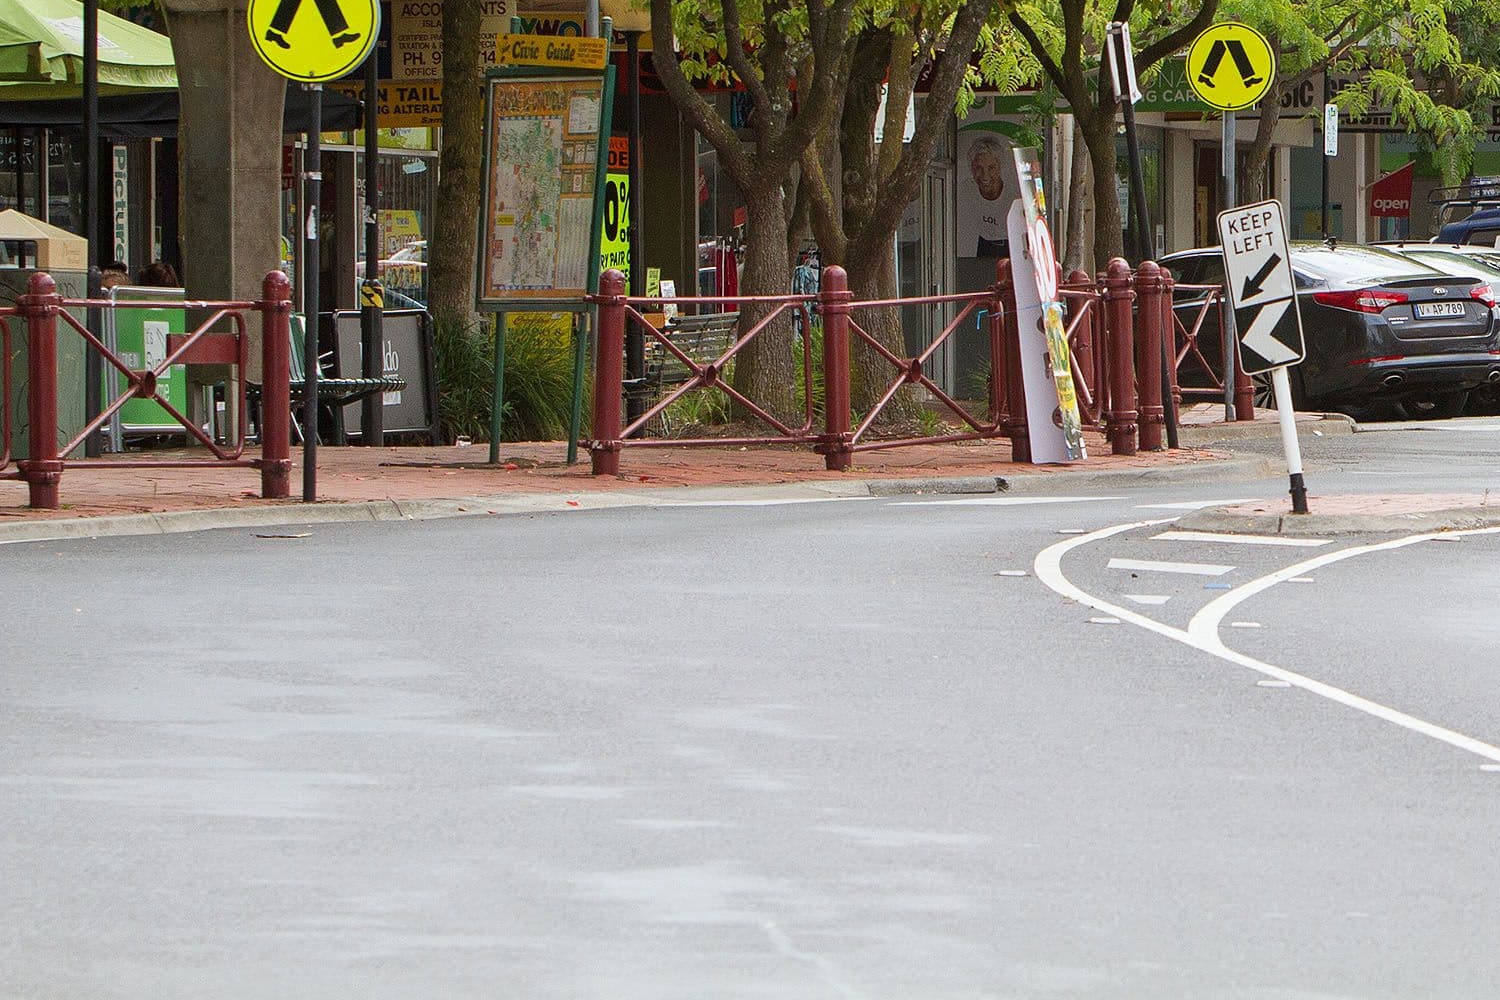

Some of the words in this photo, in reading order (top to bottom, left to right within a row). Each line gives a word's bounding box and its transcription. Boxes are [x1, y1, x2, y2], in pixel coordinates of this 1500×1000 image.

[512, 40, 540, 59] Civic
[546, 41, 576, 62] Guide
[404, 67, 438, 76] OFFICE
[1374, 198, 1410, 212] open
[1228, 211, 1273, 235] KEEP
[1233, 231, 1274, 255] LEFT
